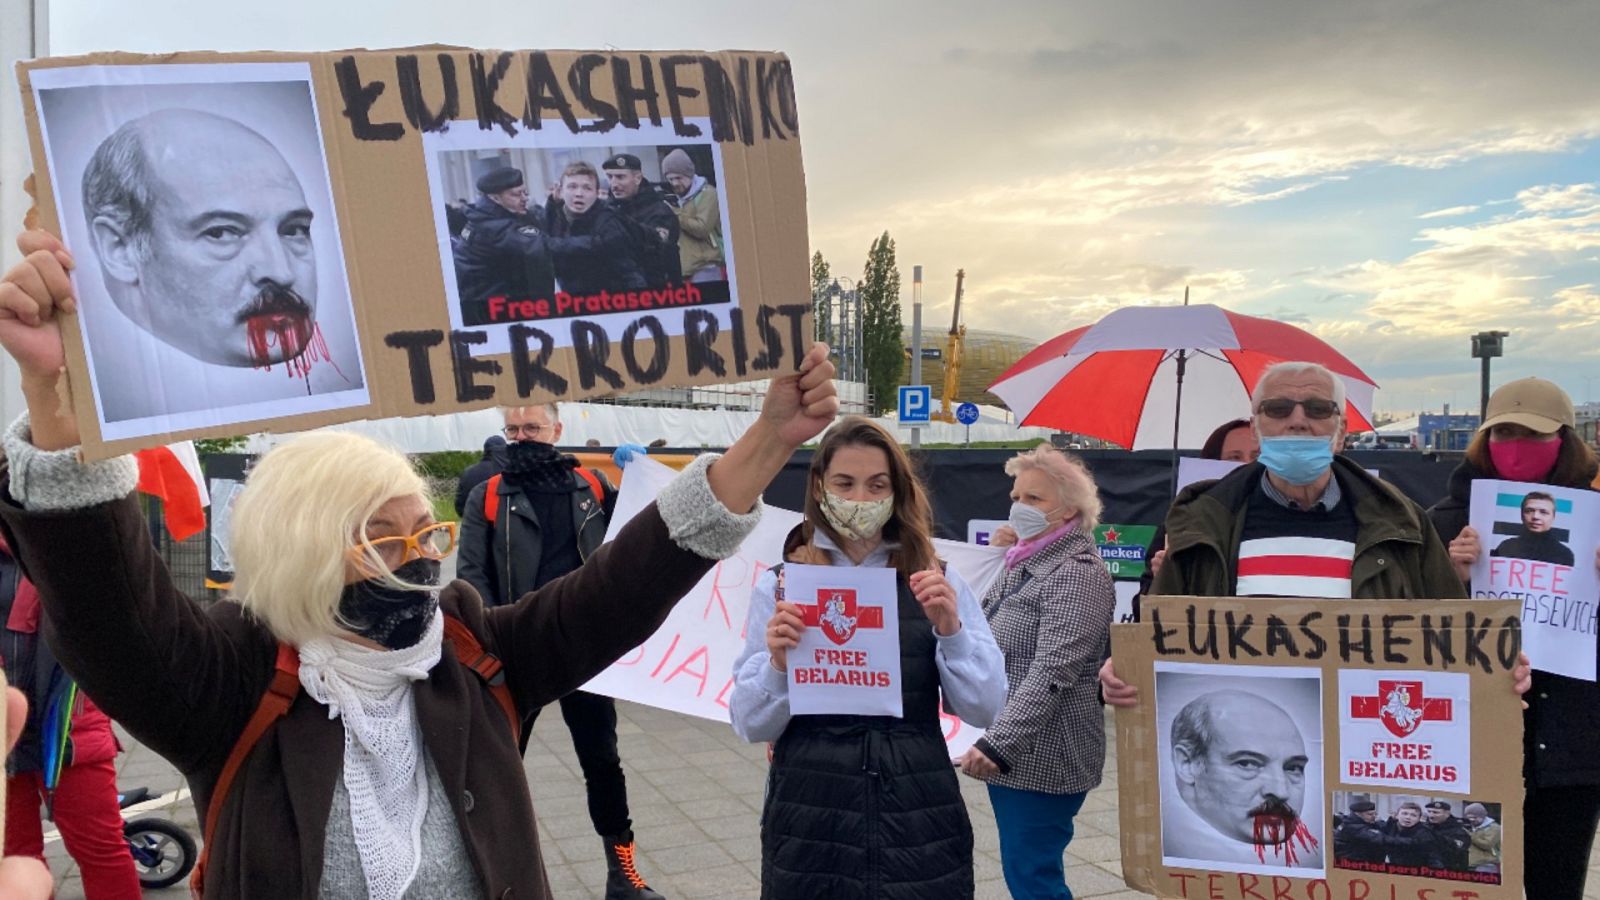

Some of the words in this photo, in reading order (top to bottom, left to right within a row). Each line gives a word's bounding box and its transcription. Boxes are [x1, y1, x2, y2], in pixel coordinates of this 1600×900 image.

[334, 52, 799, 147] ŁUKASHENKO
[488, 295, 549, 321] Free
[554, 282, 702, 314] Pratasevich
[385, 303, 812, 405] TERRORIST
[905, 390, 924, 417] P
[1098, 546, 1142, 559] ineken
[1489, 559, 1573, 595] FREE
[1475, 591, 1597, 635] ASEVICH
[1151, 604, 1522, 675] ŁUKASHENKO
[815, 648, 867, 667] FREE
[794, 667, 891, 688] BELARUS
[1371, 742, 1433, 760] FREE
[1348, 761, 1458, 783] BELARUS
[1388, 864, 1418, 876] para
[1420, 866, 1499, 883] Pratasevich
